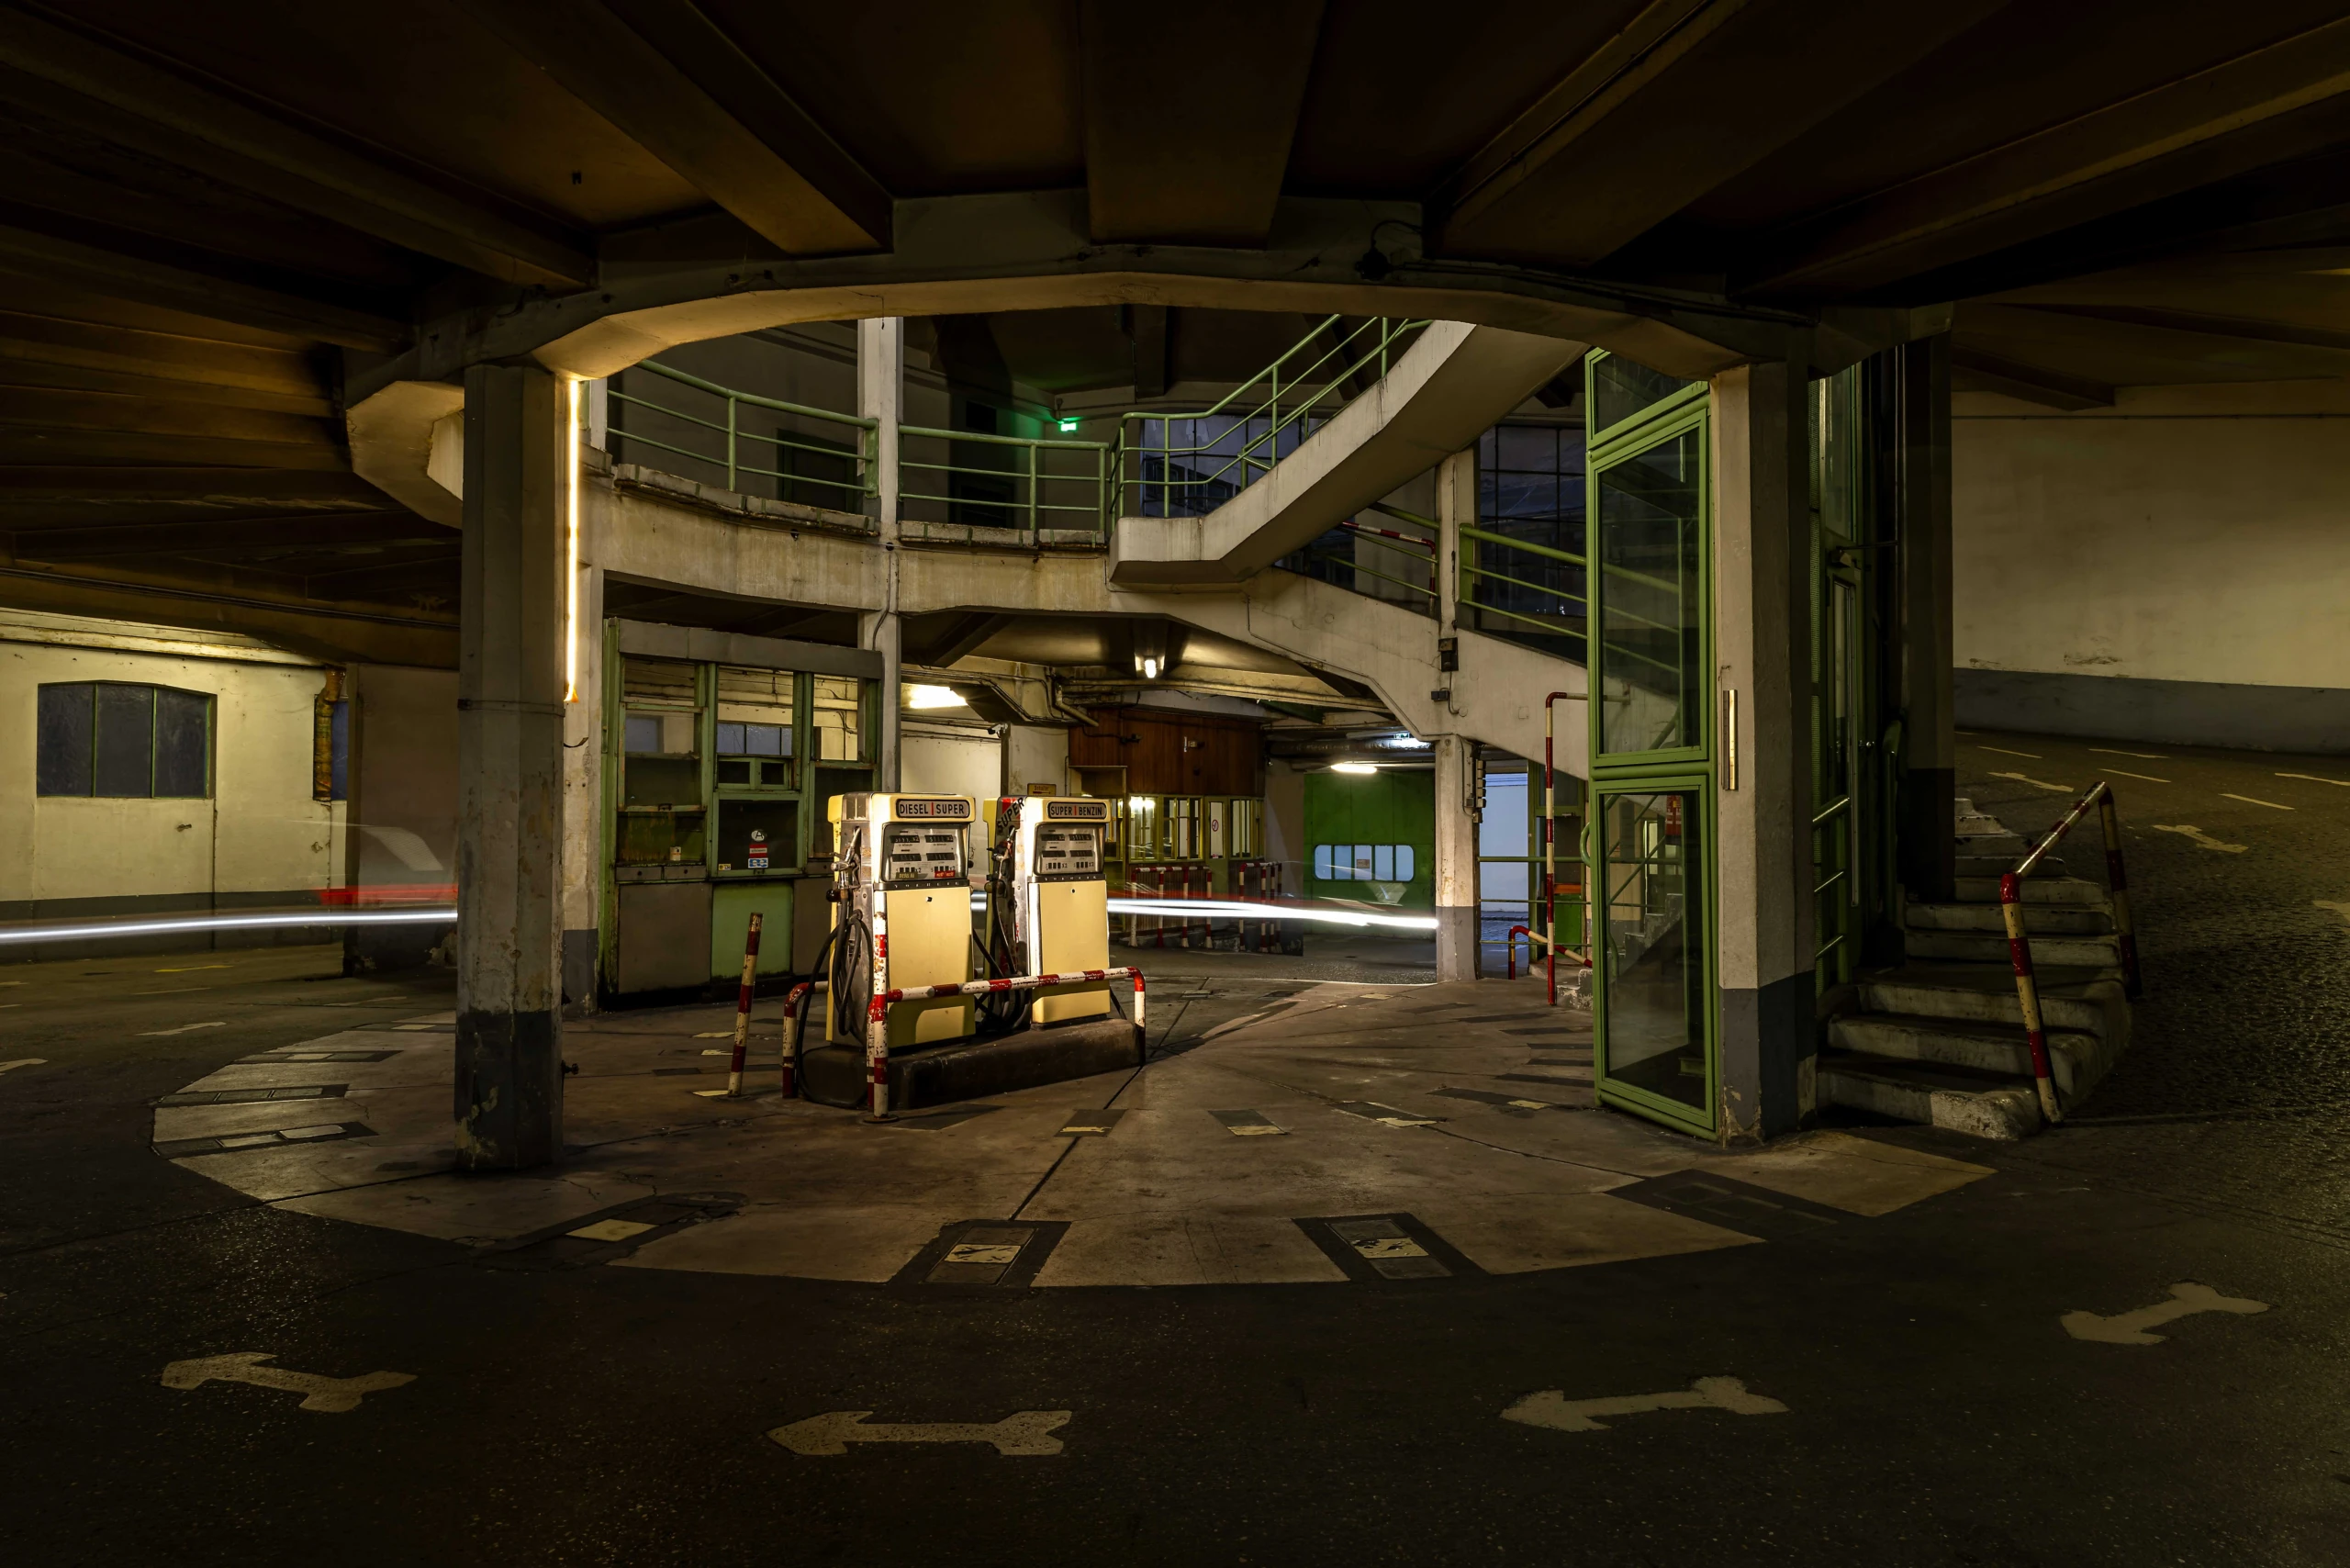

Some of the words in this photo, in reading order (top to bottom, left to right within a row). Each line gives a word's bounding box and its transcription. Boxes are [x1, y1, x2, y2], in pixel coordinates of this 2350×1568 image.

[900, 803, 928, 814] DIESEL
[936, 803, 965, 814] SUPER
[1050, 806, 1072, 816] SUPER
[1079, 806, 1102, 816] BENZIN
[997, 797, 1024, 834] SUPER
